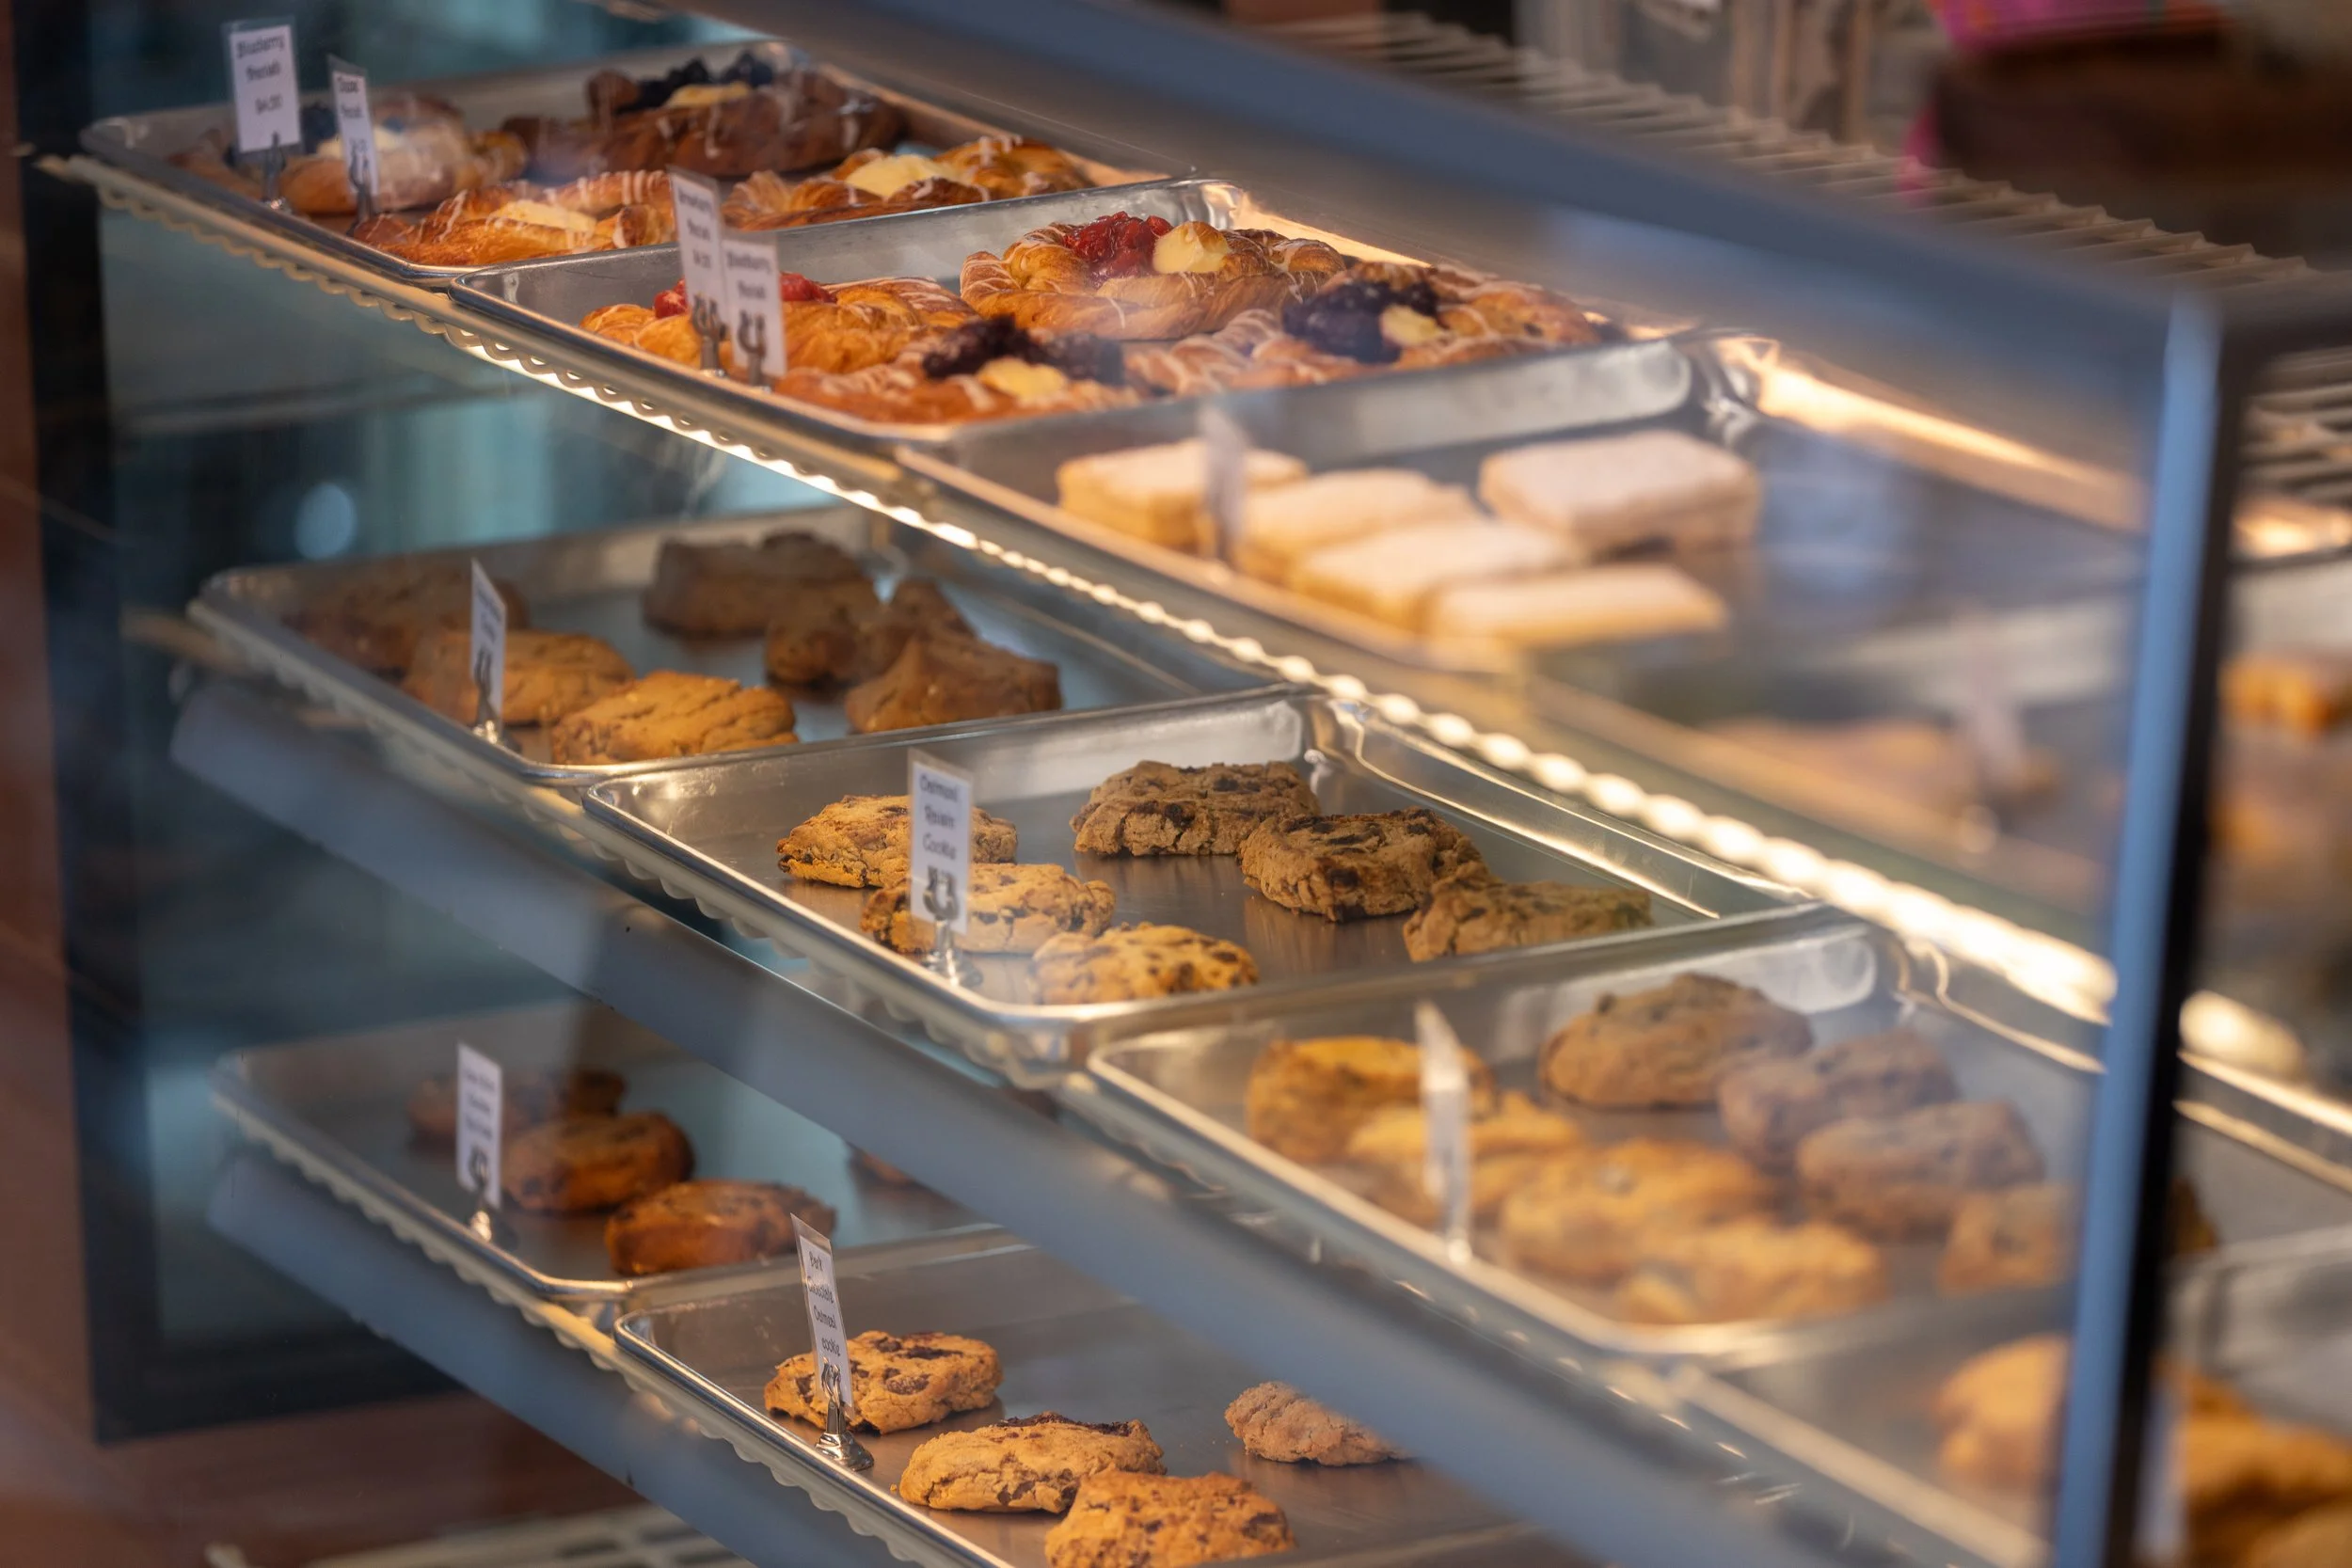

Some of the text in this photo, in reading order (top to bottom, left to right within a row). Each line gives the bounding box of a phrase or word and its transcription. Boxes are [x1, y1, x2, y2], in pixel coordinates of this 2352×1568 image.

[919, 774, 958, 802] Oatmeal
[922, 832, 957, 861] Cookie
[813, 1304, 836, 1329] Oatmeal
